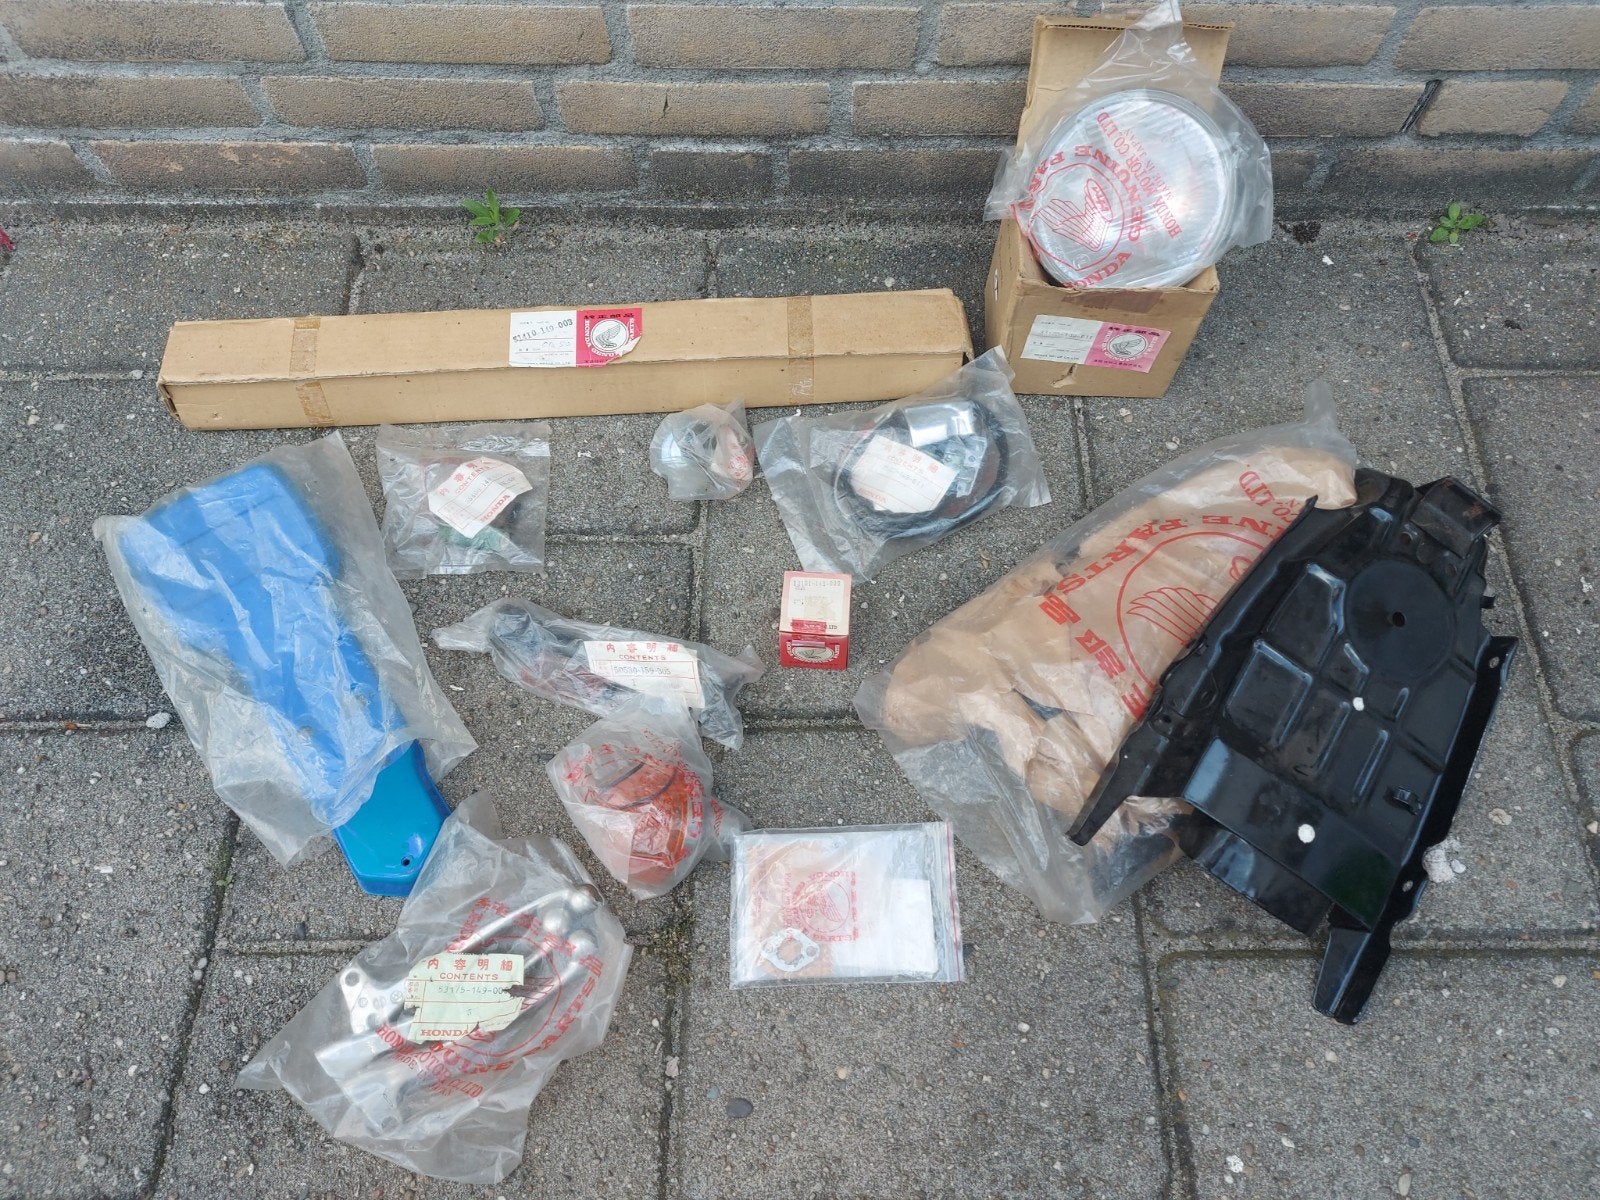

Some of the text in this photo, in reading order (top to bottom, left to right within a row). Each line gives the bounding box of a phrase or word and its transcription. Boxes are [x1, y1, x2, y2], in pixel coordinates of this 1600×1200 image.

[1074, 144, 1142, 242] GENUINE
[1124, 154, 1156, 197] MOTOR
[1151, 197, 1182, 238] HONDA
[1056, 516, 1188, 595] PARTS
[438, 986, 504, 995] 53175-149-00
[439, 973, 499, 981] CONTENTS
[420, 1029, 470, 1037] HONDA
